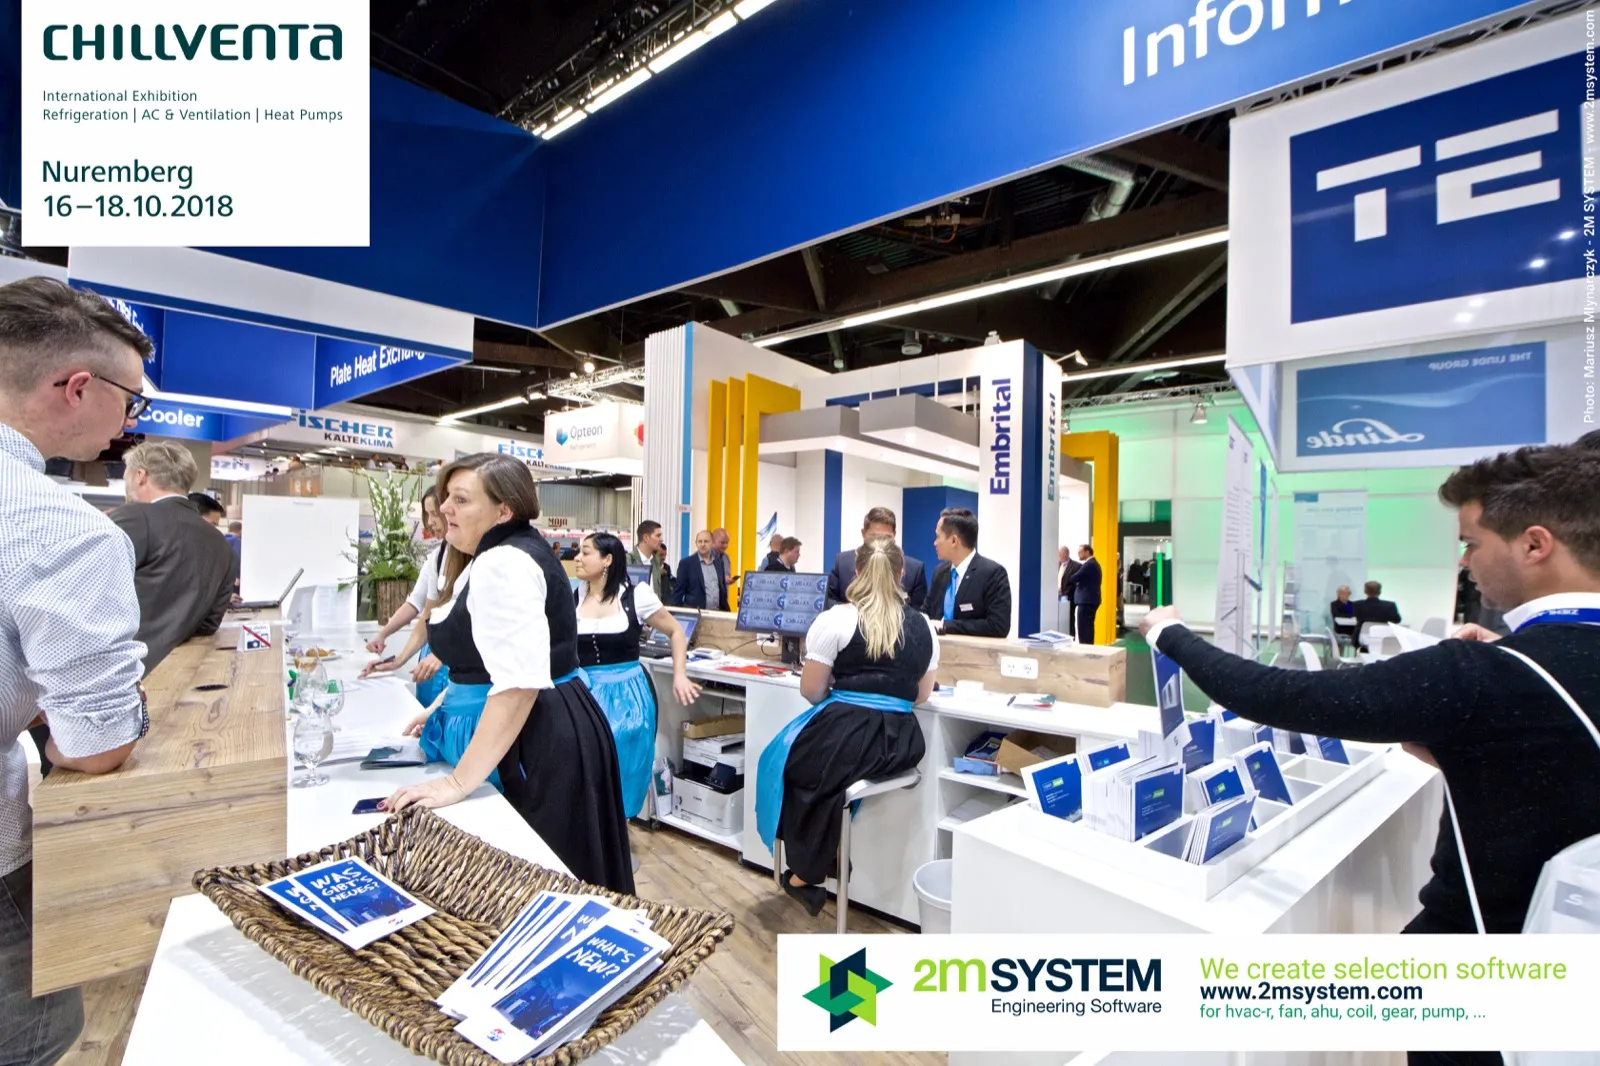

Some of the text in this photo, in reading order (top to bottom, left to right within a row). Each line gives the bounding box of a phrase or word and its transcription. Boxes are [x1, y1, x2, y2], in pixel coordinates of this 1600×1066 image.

[330, 363, 352, 388] Plate
[354, 350, 377, 378] Heat
[570, 425, 602, 441] Opteon
[990, 378, 1011, 495] Embrital
[1048, 393, 1056, 501] Embrital
[310, 867, 363, 890] WAS
[321, 875, 374, 897] GIBT'S
[329, 881, 381, 904] NEUES?
[565, 947, 621, 979] NEW?
[587, 936, 636, 963] WHAT'S
